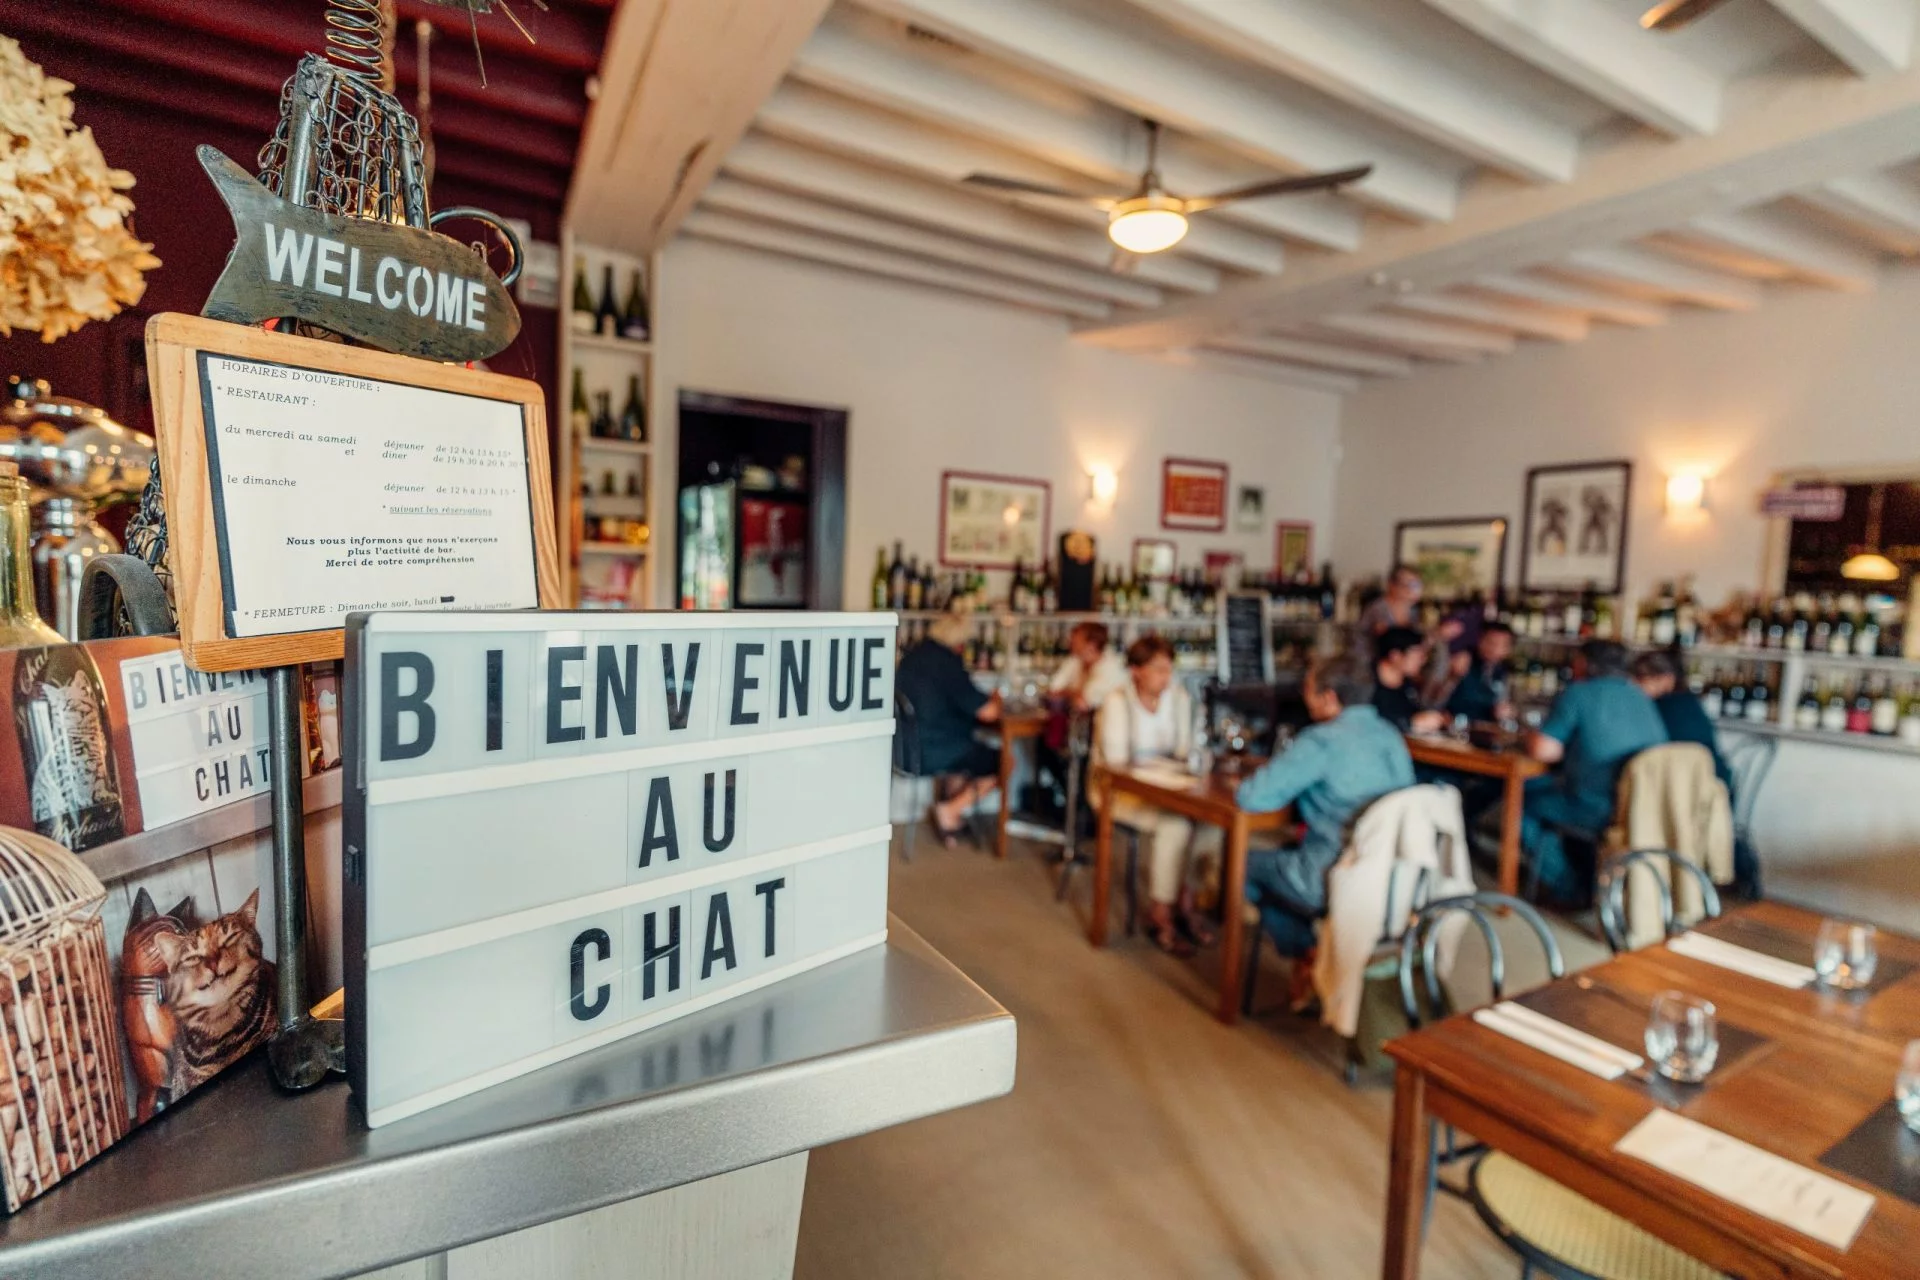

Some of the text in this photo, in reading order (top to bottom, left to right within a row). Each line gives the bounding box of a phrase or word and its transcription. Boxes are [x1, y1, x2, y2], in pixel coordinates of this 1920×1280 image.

[265, 223, 486, 331] WELCOME
[221, 361, 287, 379] HORAIRES
[292, 371, 373, 391] D'OUVERTURE
[227, 386, 309, 406] RESTAURANT
[225, 424, 357, 445] du mercredi au samedi
[344, 448, 355, 456] et
[383, 440, 425, 451] déjeuner
[435, 444, 446, 453] de
[432, 454, 444, 463] de
[227, 474, 297, 487] le dimanche
[383, 482, 425, 493] déjeuner
[436, 485, 447, 494] de
[389, 505, 424, 514] suivant
[426, 505, 439, 514] les
[286, 536, 316, 546] Nous
[320, 537, 346, 545] vous
[350, 536, 403, 547] informons
[406, 537, 423, 546] que
[325, 555, 475, 568] Merci de votre compréhension
[347, 547, 371, 558] plus
[375, 546, 421, 555] l'activité
[423, 546, 435, 554] de
[253, 604, 326, 619] FERMETURE
[337, 600, 388, 612] Dimanche
[414, 596, 438, 606] lundi
[380, 637, 886, 762] BIENVENUE
[208, 705, 241, 747] AU
[195, 749, 270, 801] CHAT
[638, 768, 737, 868] AU
[569, 877, 785, 1022] CHAT
